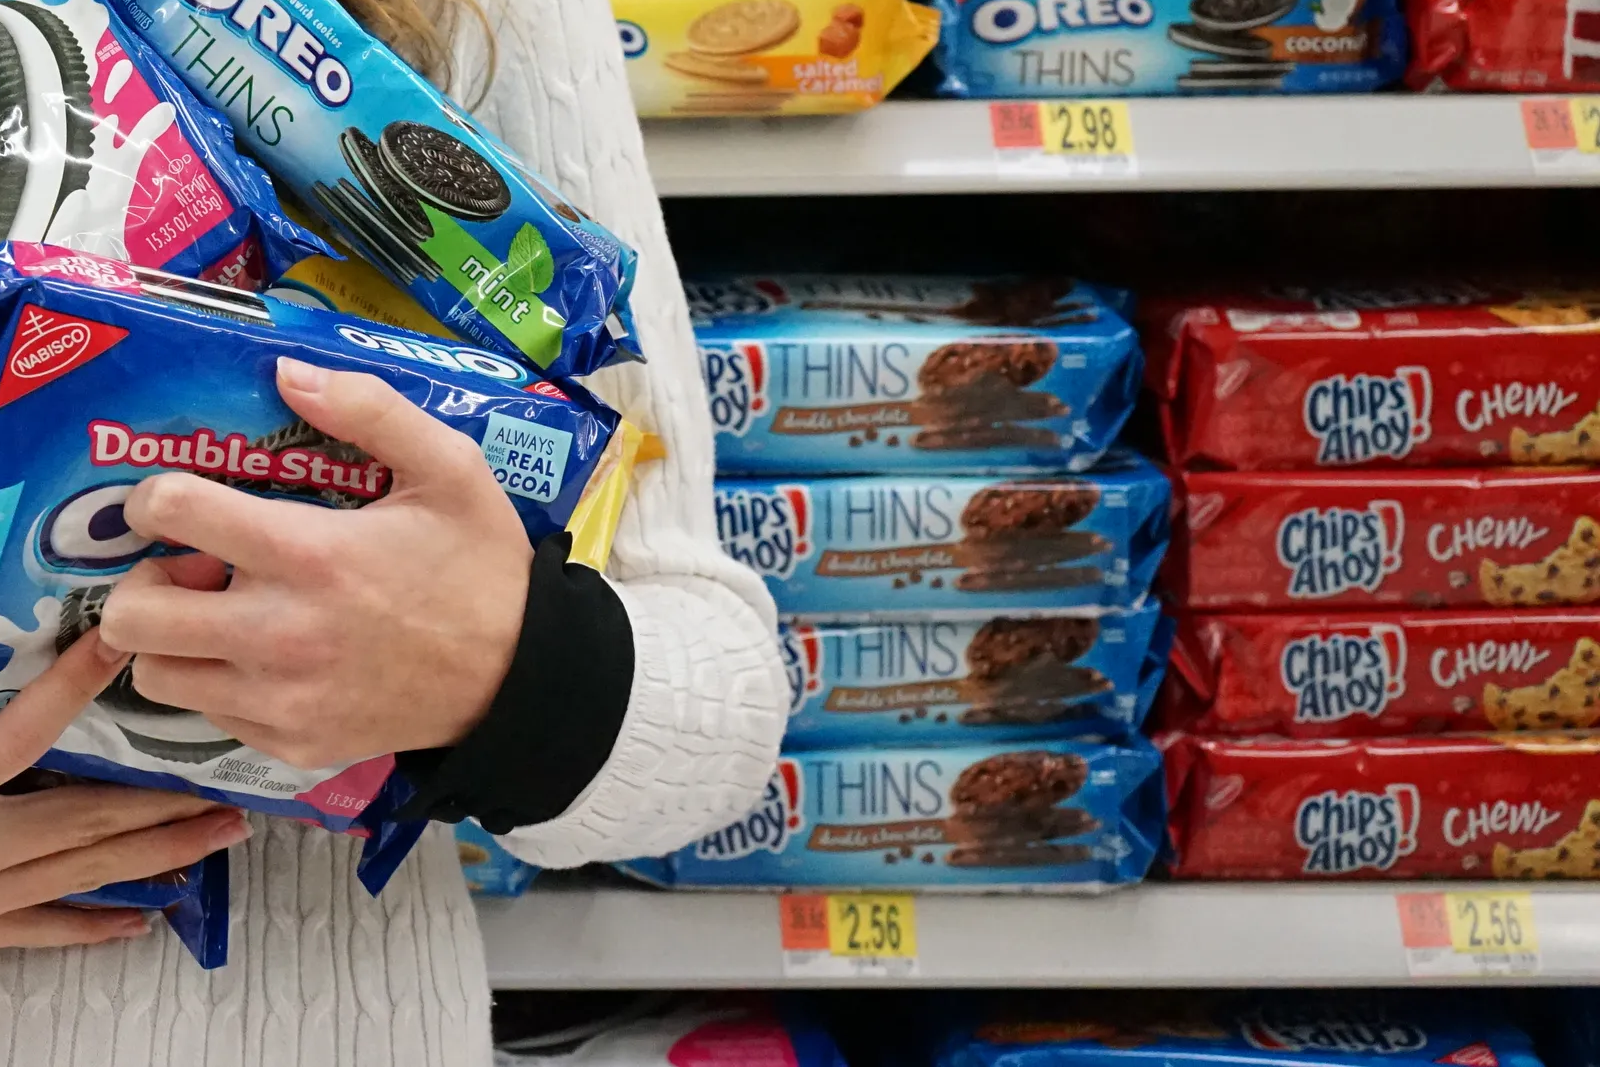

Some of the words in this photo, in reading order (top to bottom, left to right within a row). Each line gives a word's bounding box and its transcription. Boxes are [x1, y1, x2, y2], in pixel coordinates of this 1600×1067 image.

[128, 2, 153, 30] COOKIES
[312, 17, 343, 49] cookies
[171, 13, 294, 146] THINS
[793, 62, 858, 78] salted
[800, 76, 882, 93] caramel
[1013, 50, 1135, 87] THINS
[174, 185, 195, 209] NET
[193, 173, 212, 196] WT
[146, 223, 178, 252] 15.35
[174, 212, 192, 232] OZ
[187, 188, 224, 222] (435g)
[314, 273, 333, 288] thin
[350, 294, 380, 319] crispy
[460, 255, 532, 324] mint
[16, 328, 85, 373] NABISCO
[339, 327, 526, 381] OREO
[770, 343, 909, 398] THINS
[1309, 378, 1405, 426] Chips
[94, 424, 271, 476] Double
[281, 452, 388, 496] Stuf
[494, 427, 555, 456] ALWAYS
[507, 450, 555, 477] REAL
[492, 467, 551, 498] OCOA
[824, 486, 953, 541] THINS
[1282, 511, 1379, 560] Chips
[825, 625, 958, 678] THINS
[1284, 636, 1380, 688] Chips
[210, 769, 258, 786] SANDWICH
[259, 780, 299, 793] COOKIES
[218, 757, 272, 778] CHOCOLATE
[806, 762, 942, 816] THINS
[326, 792, 353, 807] 15.35
[1300, 794, 1394, 846] Chips
